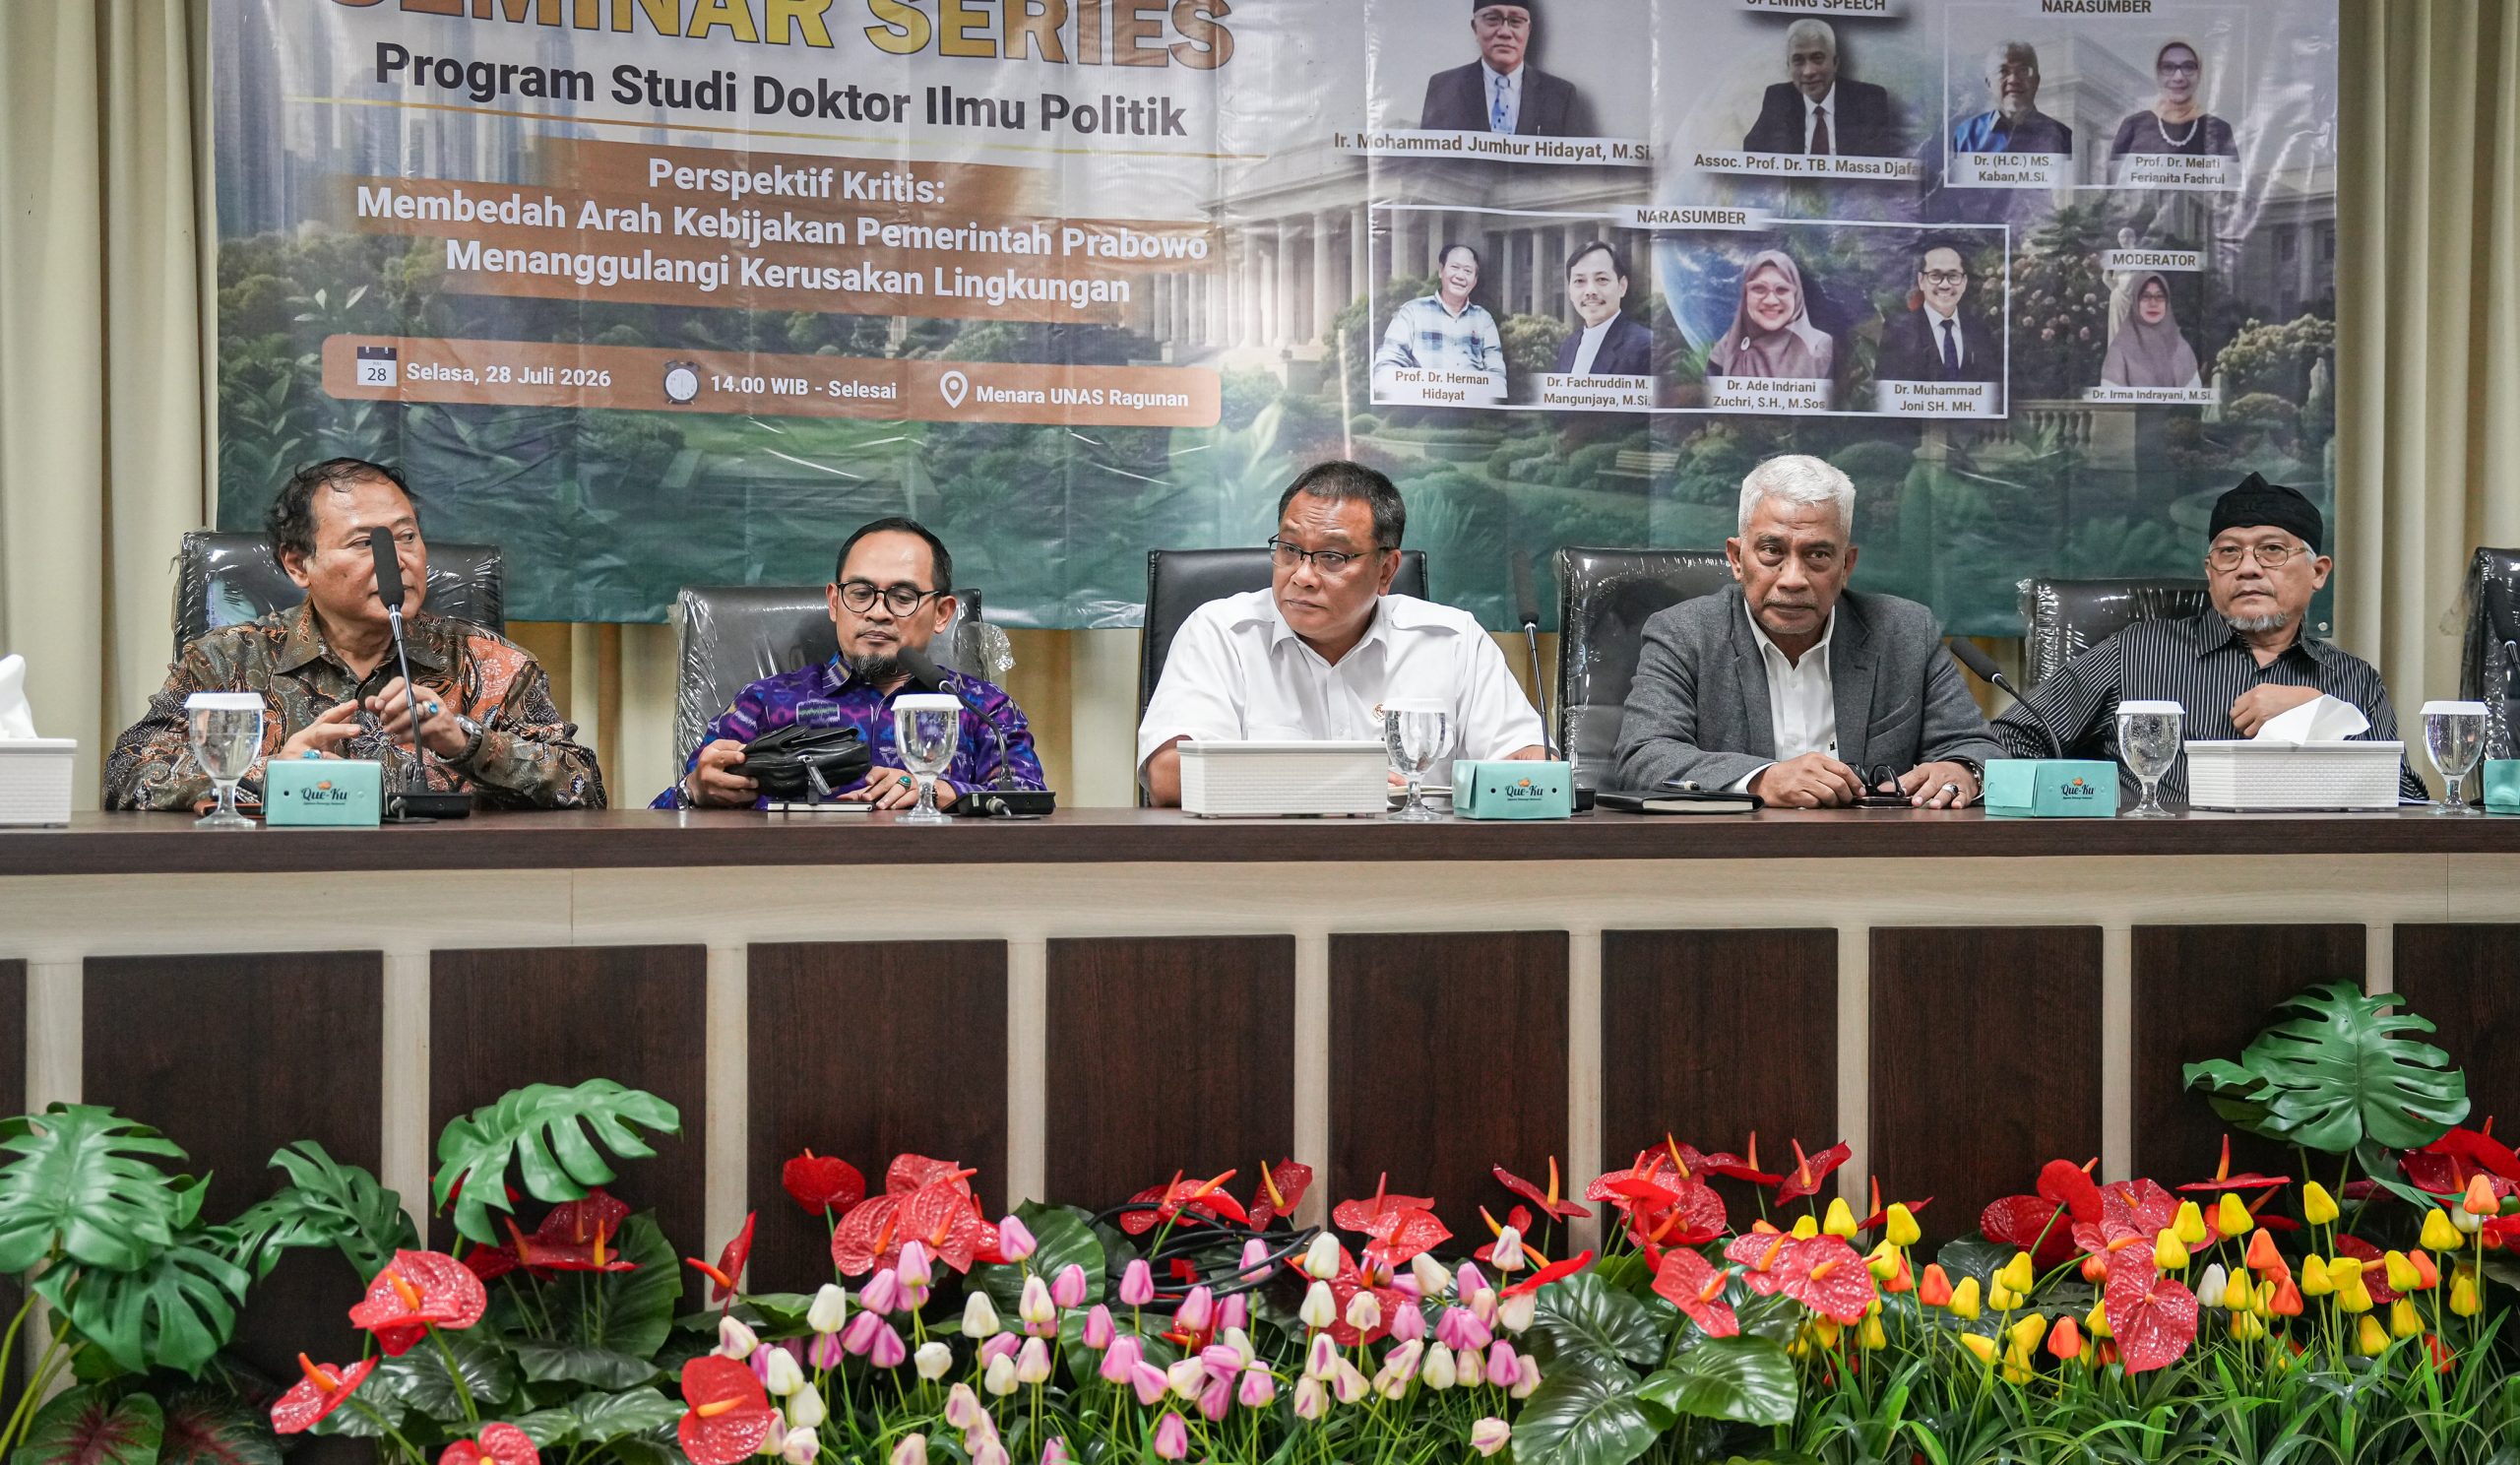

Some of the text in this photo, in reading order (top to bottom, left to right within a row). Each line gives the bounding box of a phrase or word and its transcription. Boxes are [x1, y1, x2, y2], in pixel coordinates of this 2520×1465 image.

[1822, 0, 1885, 11] SPEECH
[2042, 0, 2152, 13] NARASUMBER
[863, 0, 1234, 70] SERIES
[376, 41, 1188, 138] Program Studi Doktor Ilmu Politik
[1334, 132, 1654, 161] Ir. Mohammad Jumhur Hidayat, M.Si.
[1694, 154, 1741, 167] Assoc.
[1746, 156, 1779, 170] Prof.
[1784, 158, 1802, 171] Dr.
[1806, 159, 1831, 172] TB.
[1836, 159, 1880, 174] Massa
[1974, 156, 2053, 168] Dr. (H.C.) MS.
[2135, 157, 2221, 168] Prof. Dr. Melati
[649, 158, 945, 204] Perspektif Kritis:
[2130, 172, 2180, 184] Ferianita
[356, 186, 1209, 261] Membedah Arah Kebijakan Pemerintah Prabowo
[1637, 209, 1746, 224] NARASUMBER
[2112, 254, 2196, 266] MODERATOR
[446, 239, 1130, 309] Menanggulangi Kerusakan Lingkungan
[367, 367, 387, 381] 28
[407, 362, 611, 387] Selasa, 28 Juli 2026
[1395, 371, 1489, 385] Prof. Dr. Herman
[711, 375, 765, 394] 14.00
[771, 377, 809, 395] WIB
[828, 380, 897, 400] Selesai
[1546, 376, 1649, 389] Dr. Fachruddin M.
[1727, 379, 1816, 393] Dr. Ade Indriani
[1422, 388, 1465, 402] Hidayat
[1895, 384, 1982, 396] Dr. Muhammad
[2093, 390, 2107, 399] Dr.
[2110, 390, 2133, 399] Irma
[2136, 390, 2186, 402] Indrayani,
[976, 384, 1189, 412] Menara UNAS Ragunan
[1544, 393, 1652, 407] Mangunjaya, M.Si.
[1713, 396, 1753, 409] Zuchri,
[1757, 397, 1786, 410] S.H.,
[1900, 401, 1976, 413] Joni SH. MH.
[301, 788, 347, 800] Que-Ku
[1505, 785, 1544, 797] Que-Ku
[2060, 784, 2095, 796] Que-Ku
